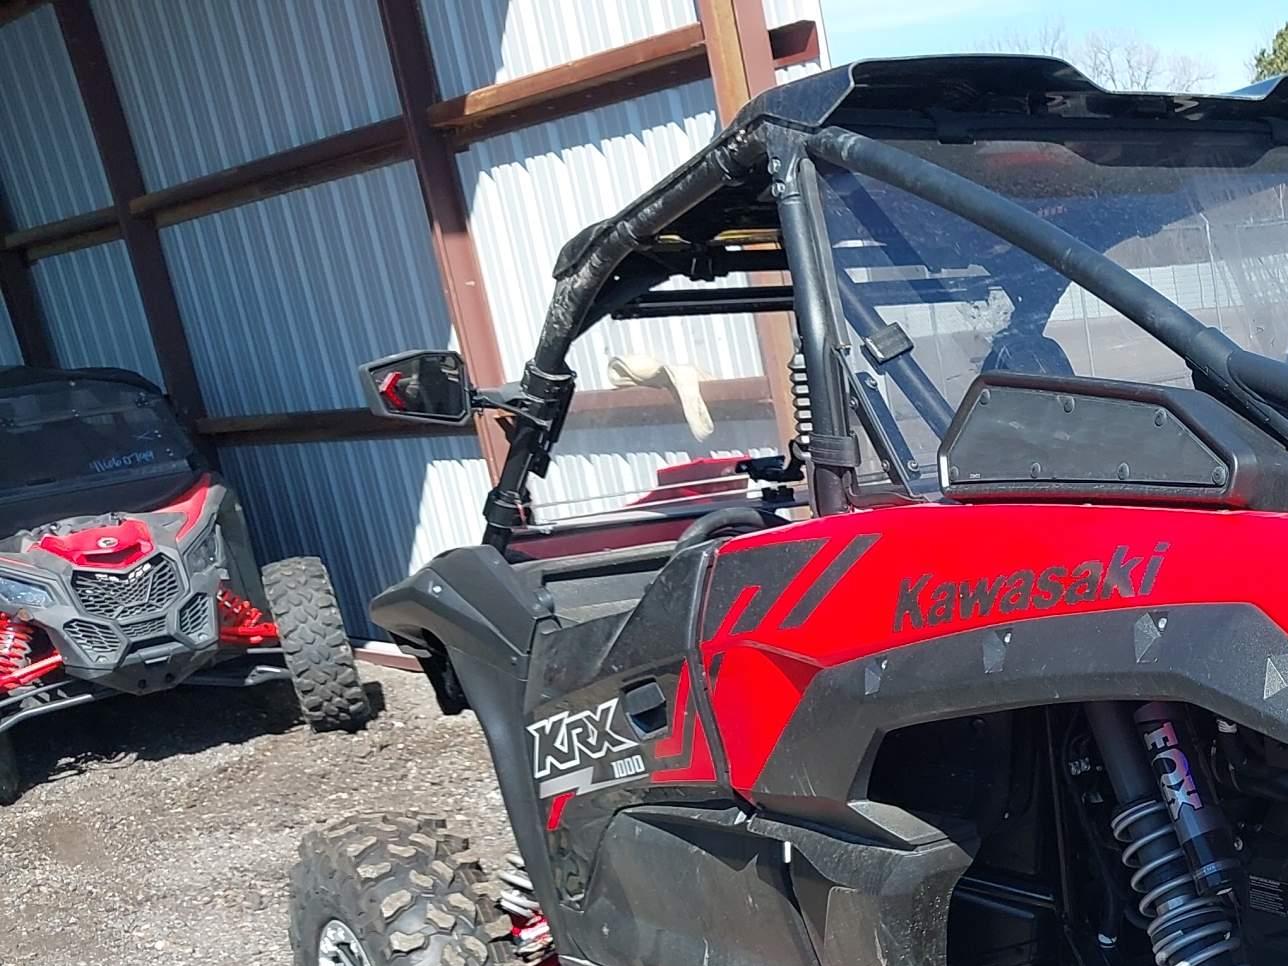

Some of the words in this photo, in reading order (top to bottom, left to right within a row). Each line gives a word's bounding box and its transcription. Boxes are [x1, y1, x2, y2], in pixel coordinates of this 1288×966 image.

[893, 541, 1171, 632] Kawasaki
[526, 698, 640, 779] KRX
[611, 754, 646, 779] 1000
[1144, 721, 1204, 822] FOX
